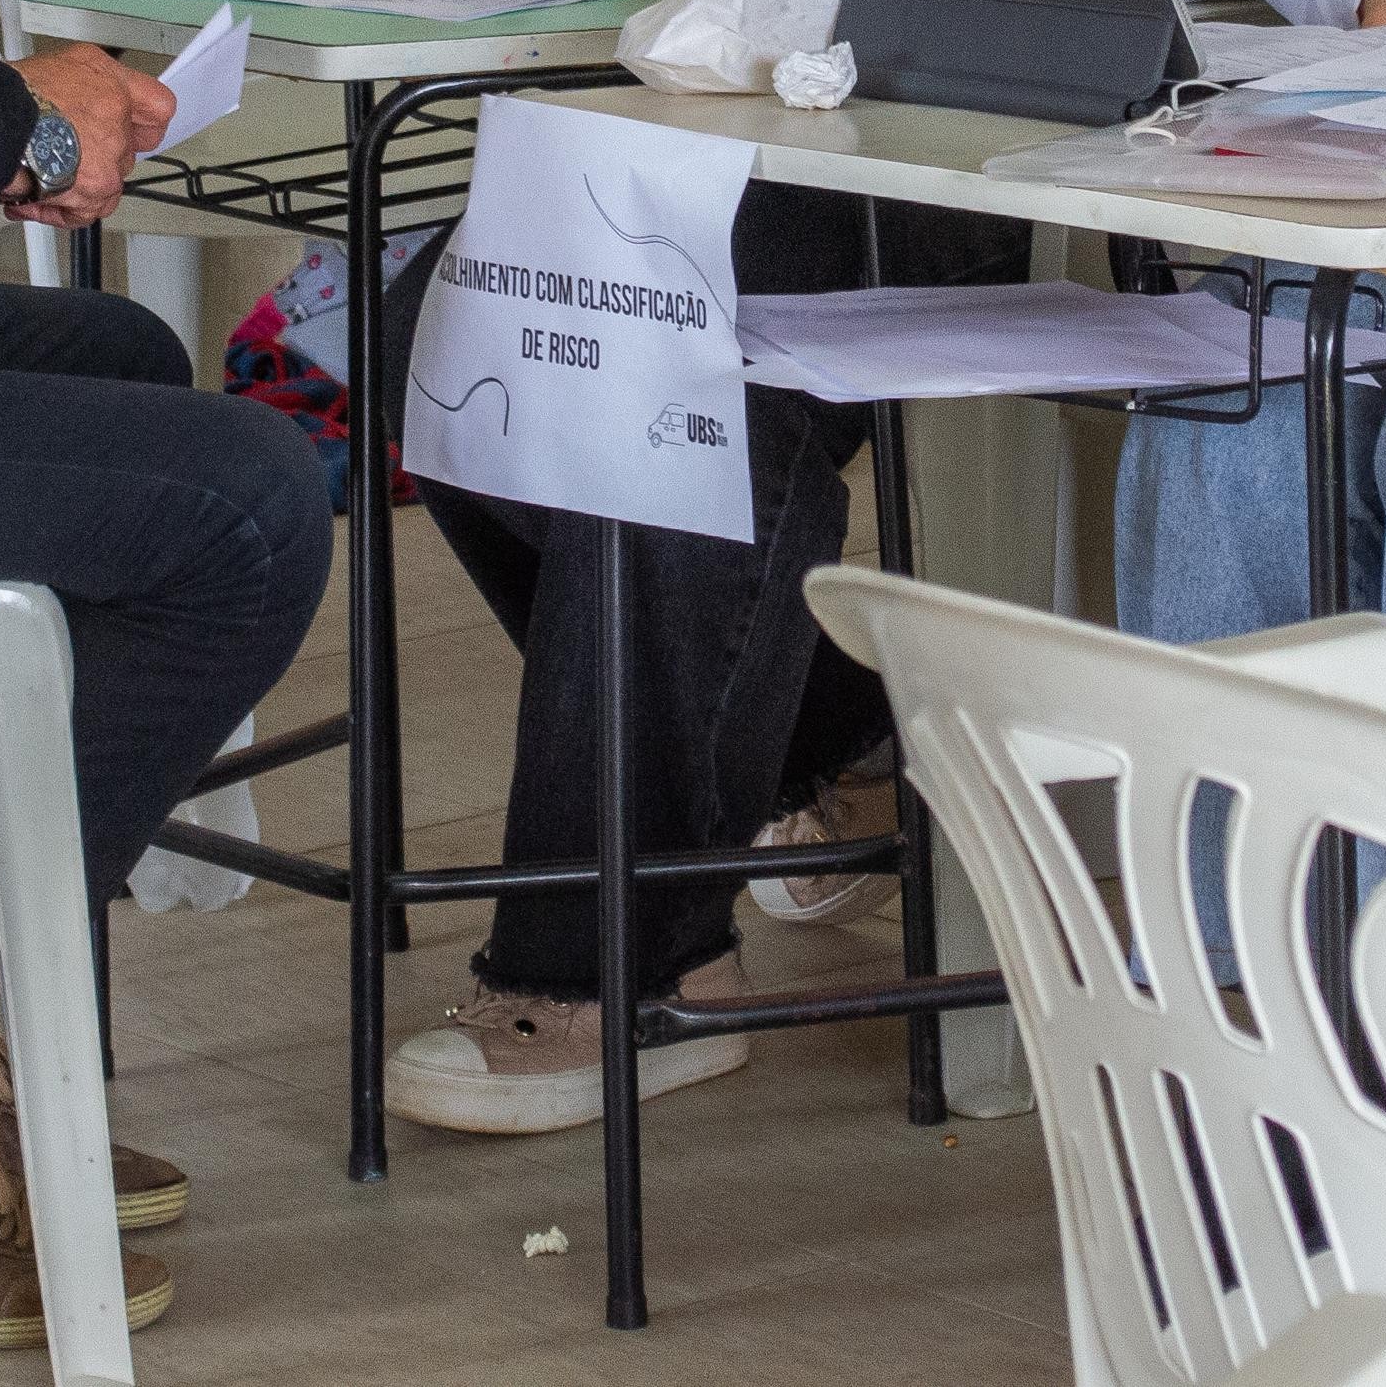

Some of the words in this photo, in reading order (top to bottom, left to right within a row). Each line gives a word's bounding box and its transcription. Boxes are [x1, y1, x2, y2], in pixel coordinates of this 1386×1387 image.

[535, 269, 573, 307] COM
[578, 276, 707, 332] CLASSIFICAÇÃO
[522, 327, 544, 362] DE
[548, 331, 601, 371] RISCO
[687, 412, 717, 448] UBS
